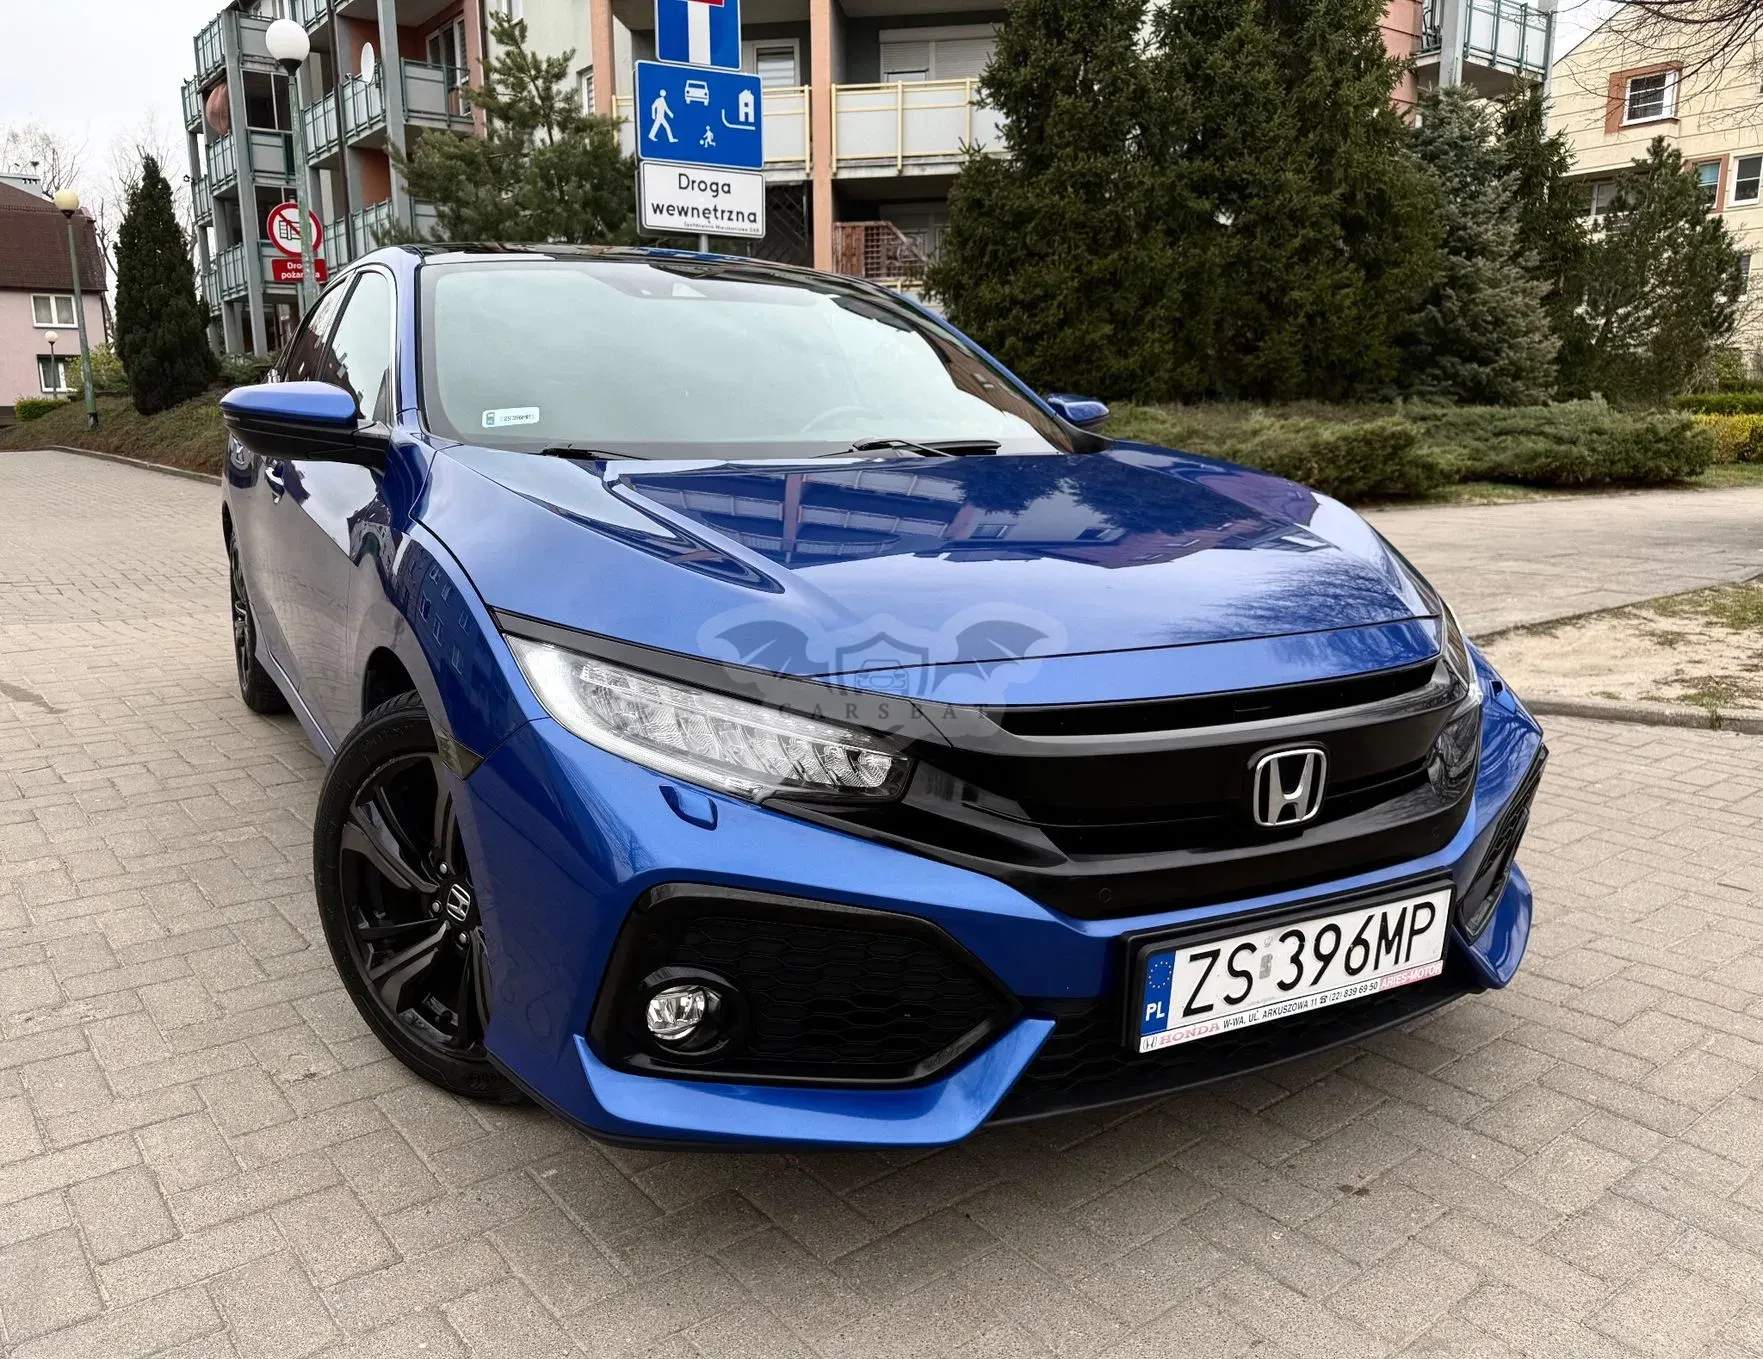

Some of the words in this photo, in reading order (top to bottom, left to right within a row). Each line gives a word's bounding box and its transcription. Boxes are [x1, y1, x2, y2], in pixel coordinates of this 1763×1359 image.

[678, 173, 731, 198] Droga
[651, 202, 757, 225] wewnętrzna
[281, 270, 320, 280] pożara
[287, 262, 303, 270] Dro
[1182, 942, 1258, 1018] ZS
[1276, 901, 1436, 991] 396MP
[1145, 1001, 1166, 1022] PL
[1159, 1022, 1220, 1045] HONDA
[1262, 1000, 1309, 1019] ARKUSZOWA
[1343, 987, 1358, 998] 839
[1358, 984, 1368, 994] 69
[1369, 981, 1378, 991] 50
[1381, 963, 1442, 989] ARIES-MOTOR
